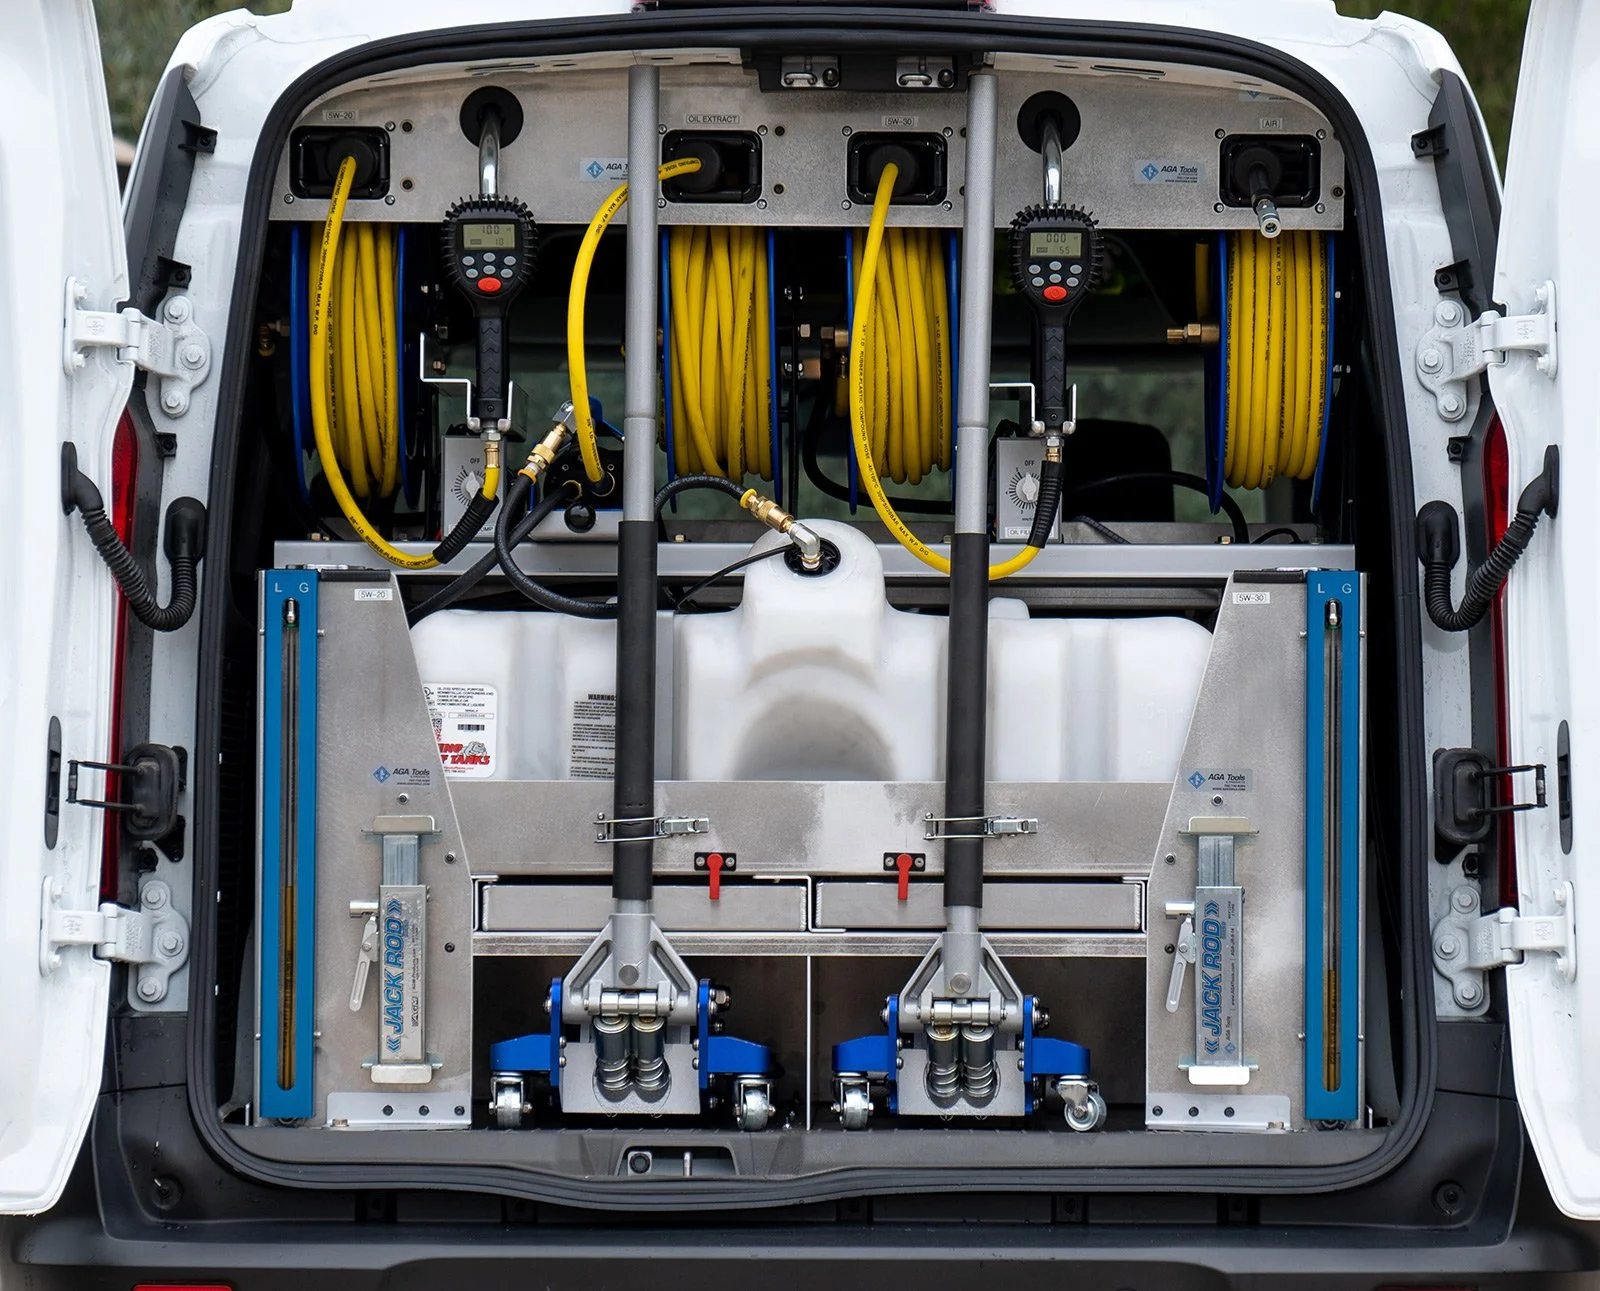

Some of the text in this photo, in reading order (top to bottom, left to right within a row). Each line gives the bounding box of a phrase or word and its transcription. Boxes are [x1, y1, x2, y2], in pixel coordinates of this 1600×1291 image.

[688, 115, 738, 123] OIL EXTRACT
[887, 118, 912, 126] 5W-30
[605, 162, 622, 171] AGA
[1160, 165, 1177, 173] AGA
[470, 457, 480, 465] OFF
[274, 582, 309, 593] L G
[1317, 583, 1352, 594] L G
[450, 754, 491, 765] TANKS
[411, 768, 430, 776] Tools
[1227, 773, 1246, 781] Tools
[383, 916, 405, 1034] JACK ROD
[1201, 918, 1222, 1037] JACK ROD
